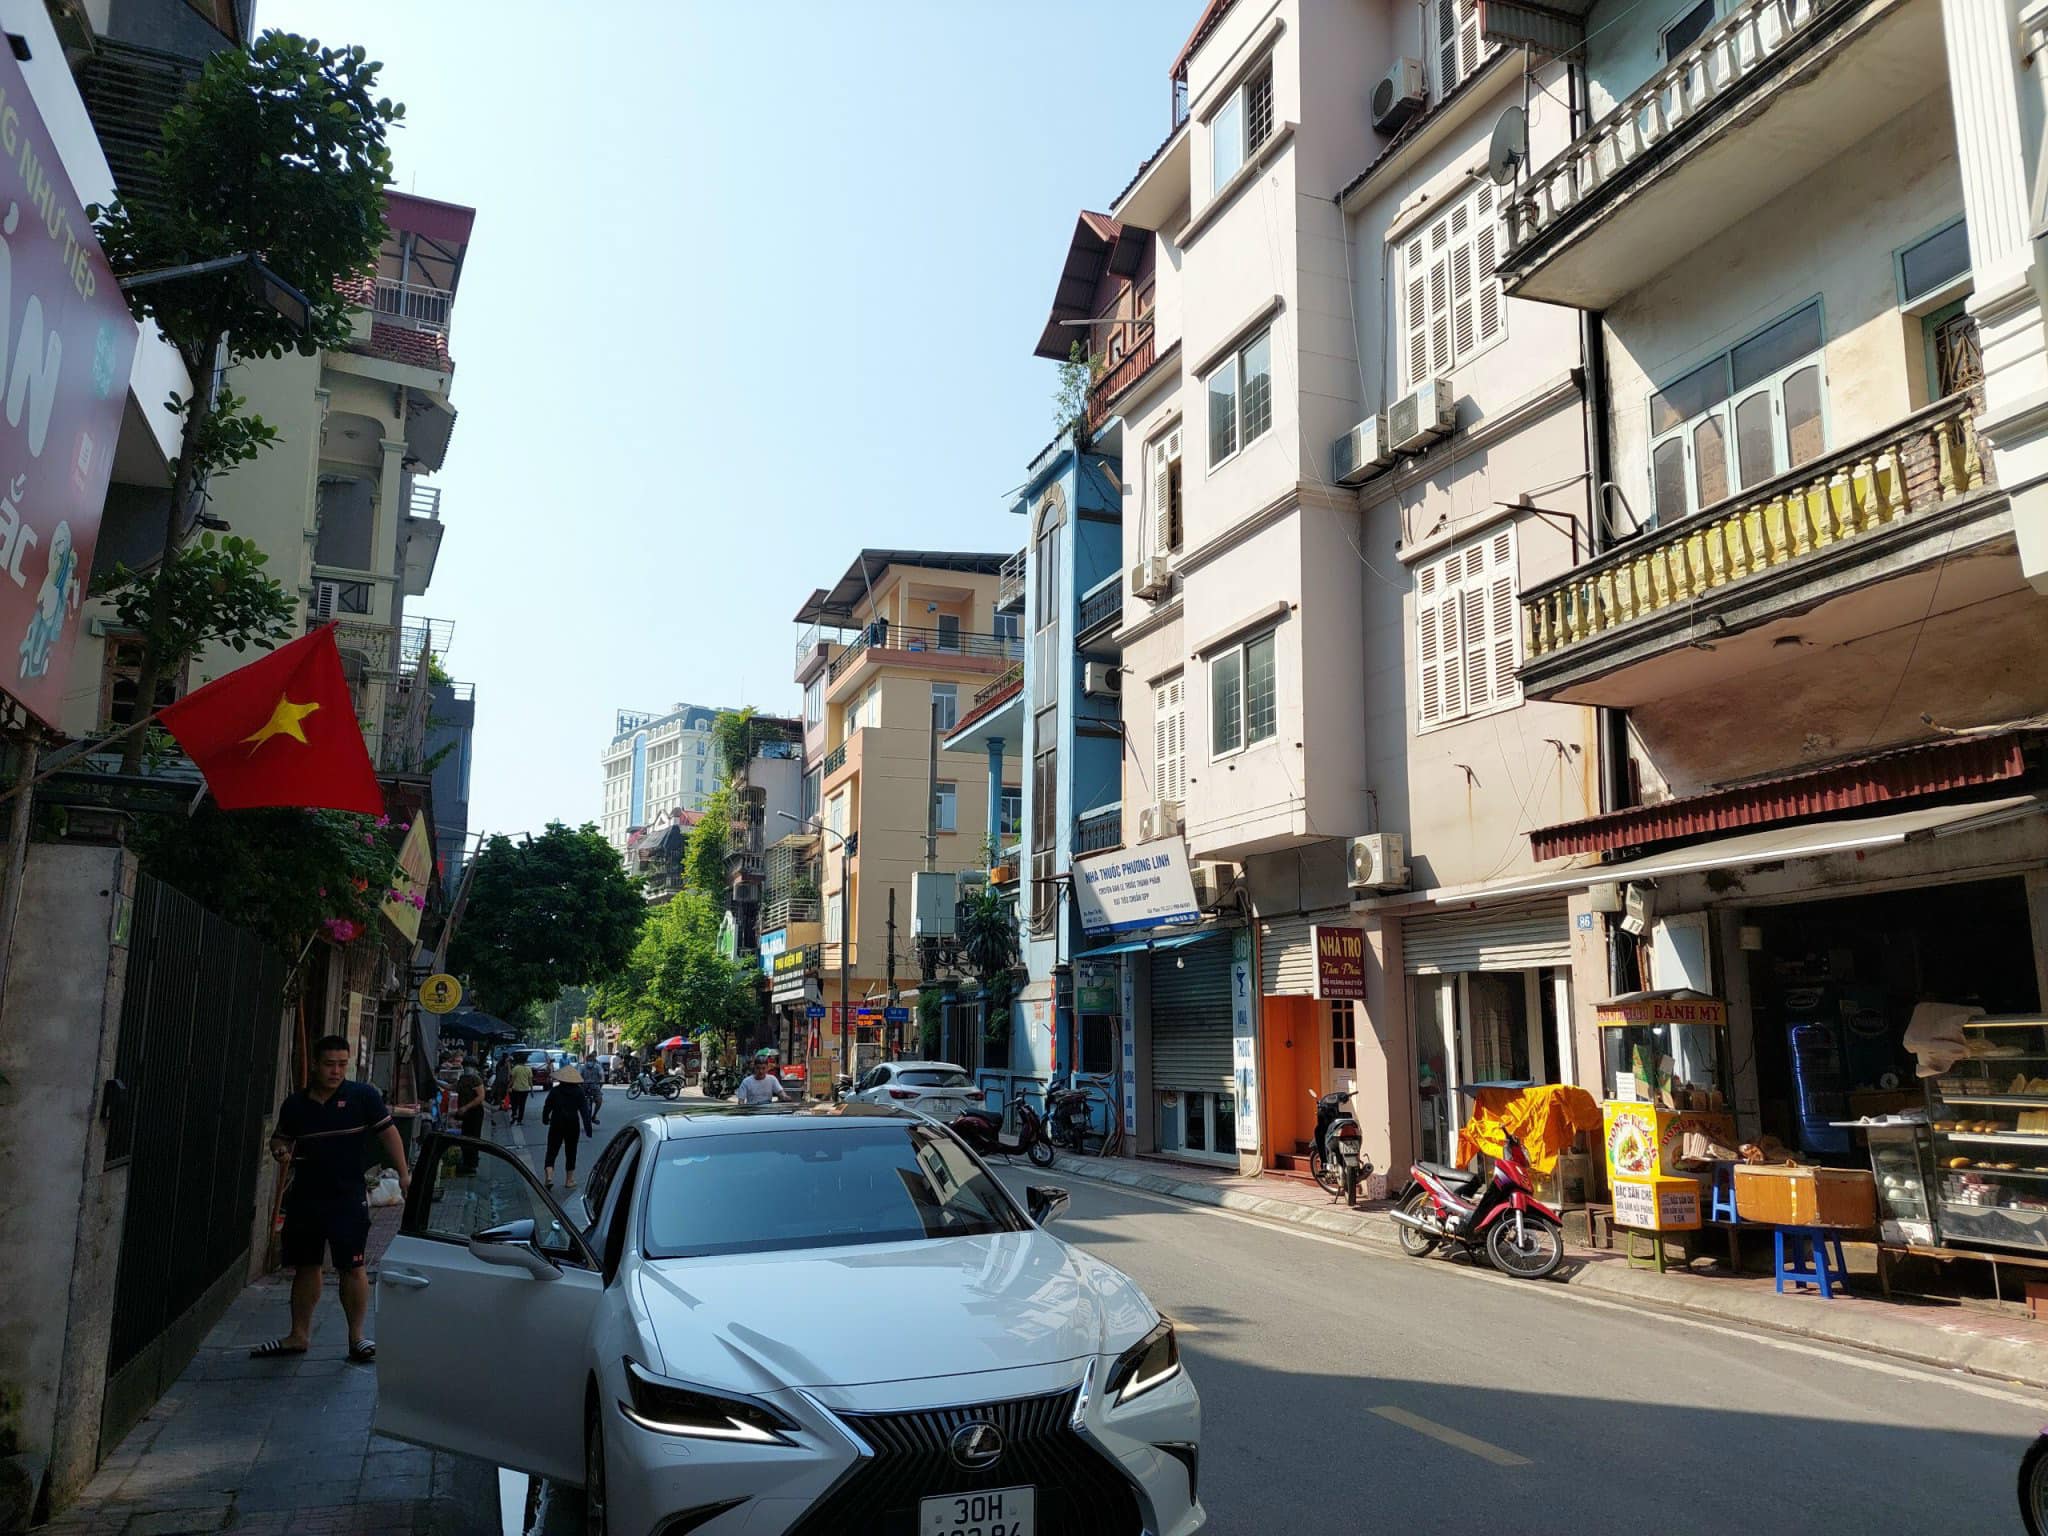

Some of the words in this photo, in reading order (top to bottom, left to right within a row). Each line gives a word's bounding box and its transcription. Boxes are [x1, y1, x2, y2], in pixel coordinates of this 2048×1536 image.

[0, 86, 20, 158] G
[19, 137, 66, 240] NHƯ
[63, 223, 96, 303] TIẾP
[0, 202, 62, 458] N
[1085, 869, 1099, 884] NHÀ
[1100, 863, 1121, 880] THUỐC
[1122, 857, 1152, 876] PHƯƠNG
[1152, 853, 1170, 869] LINH
[1580, 915, 1590, 928] 86
[1320, 929, 1341, 957] NHÀ
[1342, 937, 1361, 964] TRỌ
[1654, 1001, 1696, 1020] BÁNH
[1635, 1214, 1649, 1226] 15K
[954, 1494, 1002, 1524] 30H
